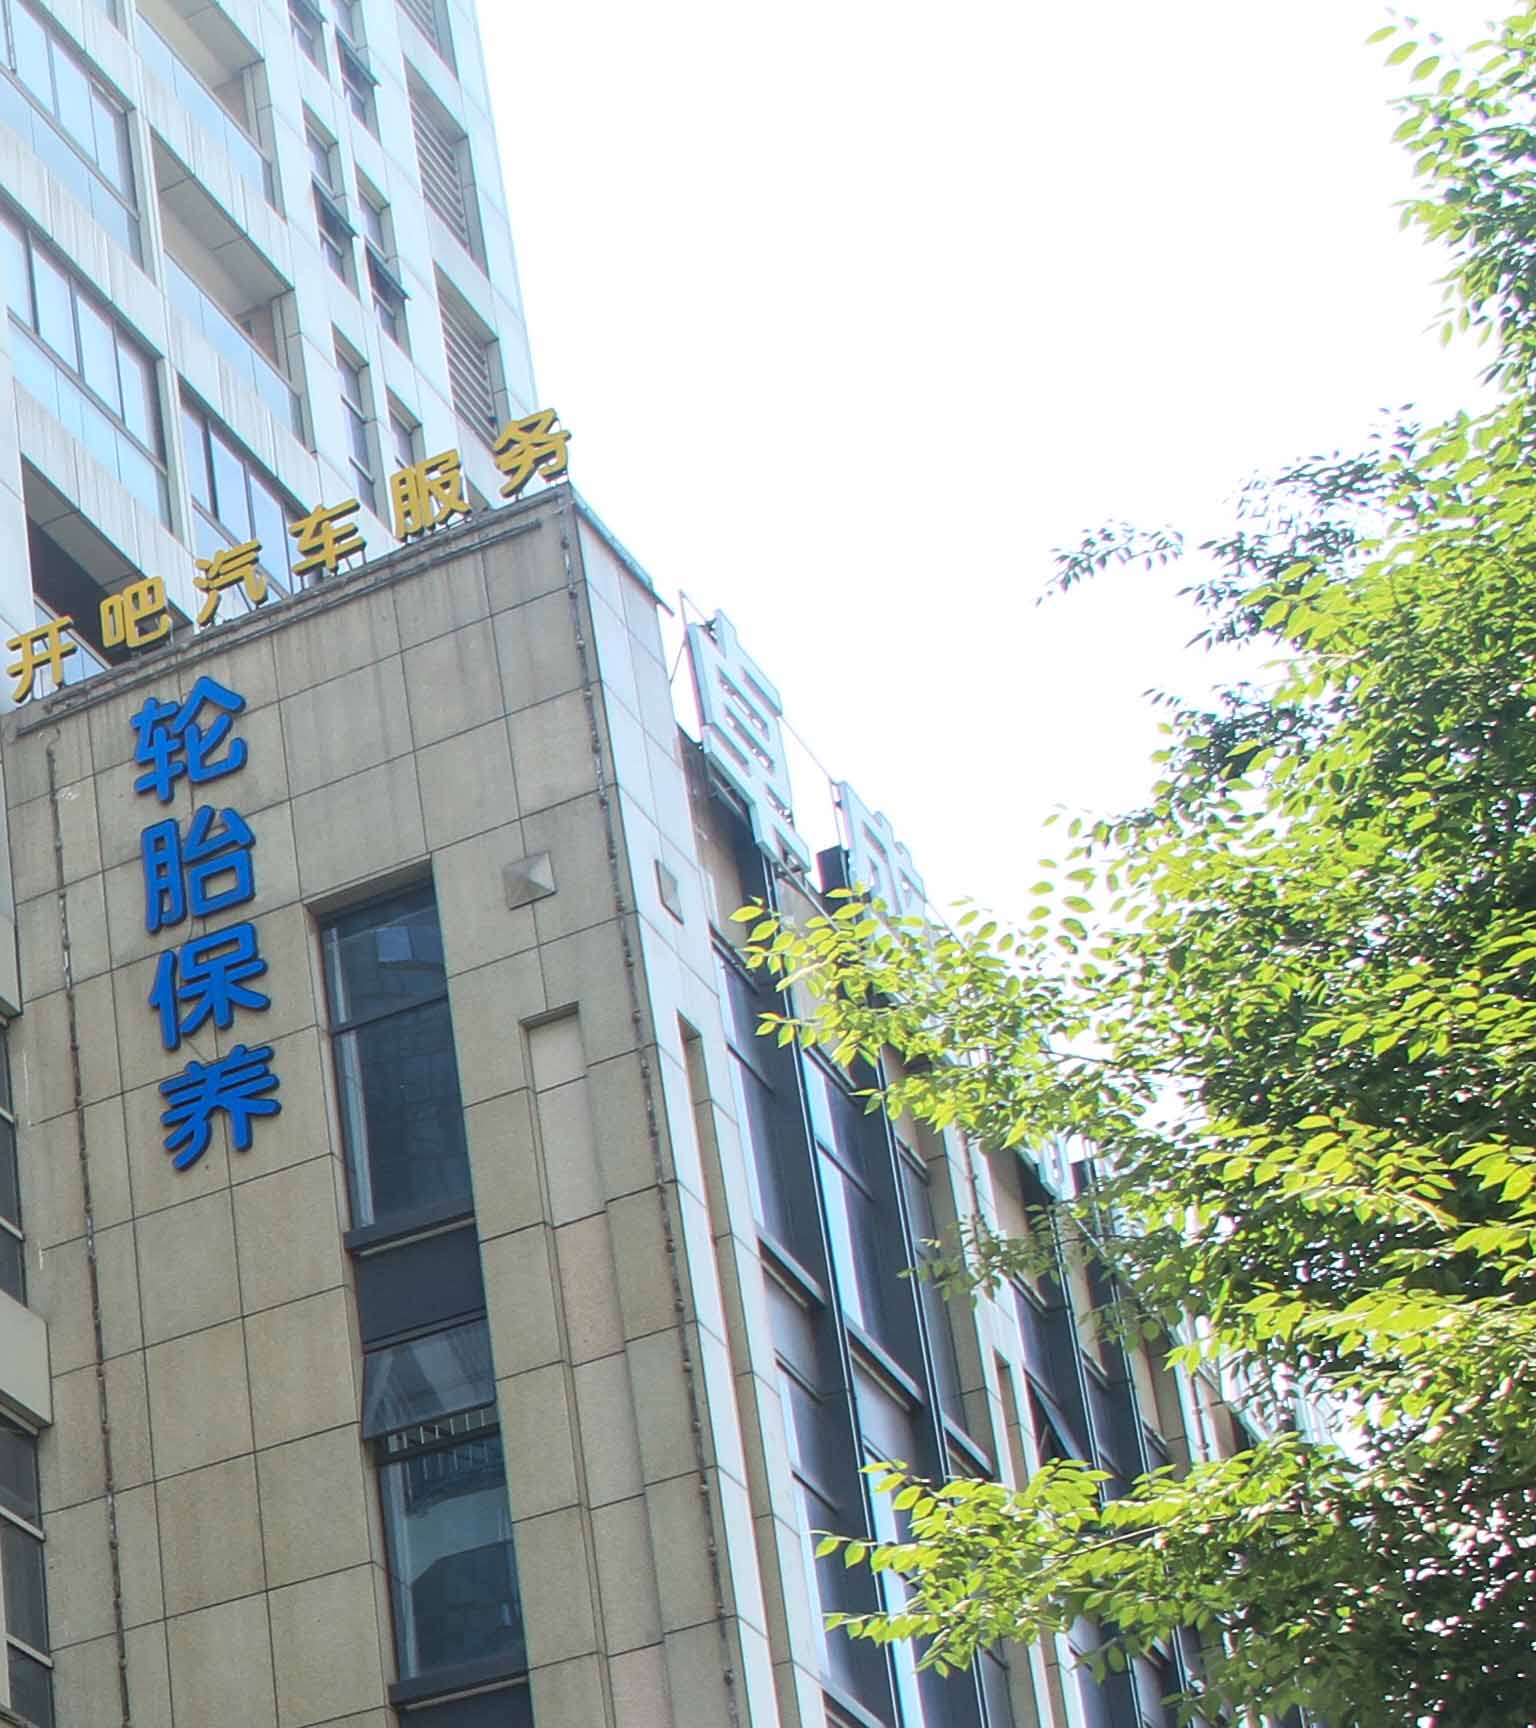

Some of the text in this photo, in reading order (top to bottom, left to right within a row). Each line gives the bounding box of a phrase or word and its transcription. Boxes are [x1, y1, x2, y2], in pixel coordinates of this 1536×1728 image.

[6, 408, 573, 703] 开吧汽车服务
[130, 674, 283, 1171] 轮胎保养
